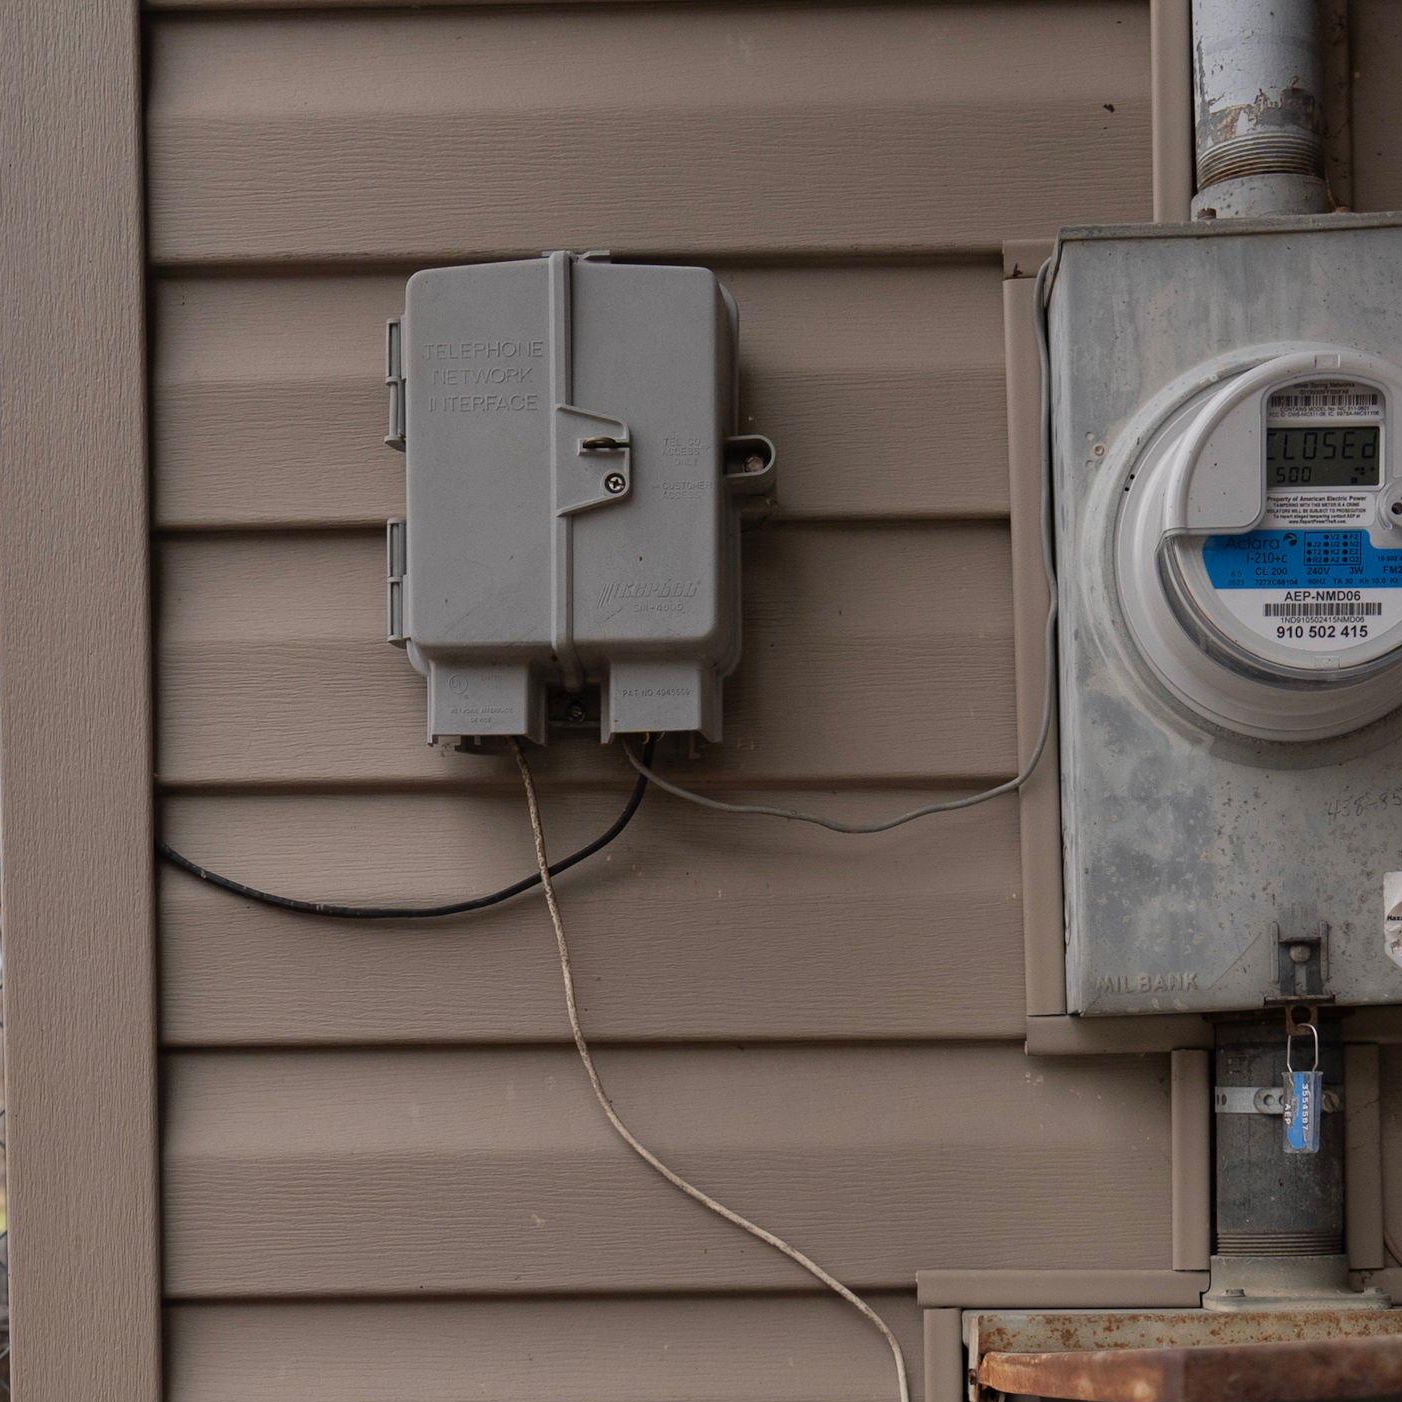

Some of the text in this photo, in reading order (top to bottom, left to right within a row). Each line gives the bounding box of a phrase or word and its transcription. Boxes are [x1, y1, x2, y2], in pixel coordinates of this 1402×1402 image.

[421, 341, 544, 360] TELEPHONE
[432, 367, 533, 385] NETWORK
[429, 394, 538, 413] INTERFACE
[1276, 466, 1312, 483] 500
[1223, 536, 1280, 550] Aclara
[1255, 567, 1268, 576] CL
[1271, 567, 1288, 576] 200
[1306, 566, 1331, 575] 240V
[1349, 566, 1364, 575] 3W
[1284, 590, 1361, 602] AEP-NMD06
[1277, 625, 1368, 638] 910 502 415
[1284, 1103, 1292, 1125] AEP
